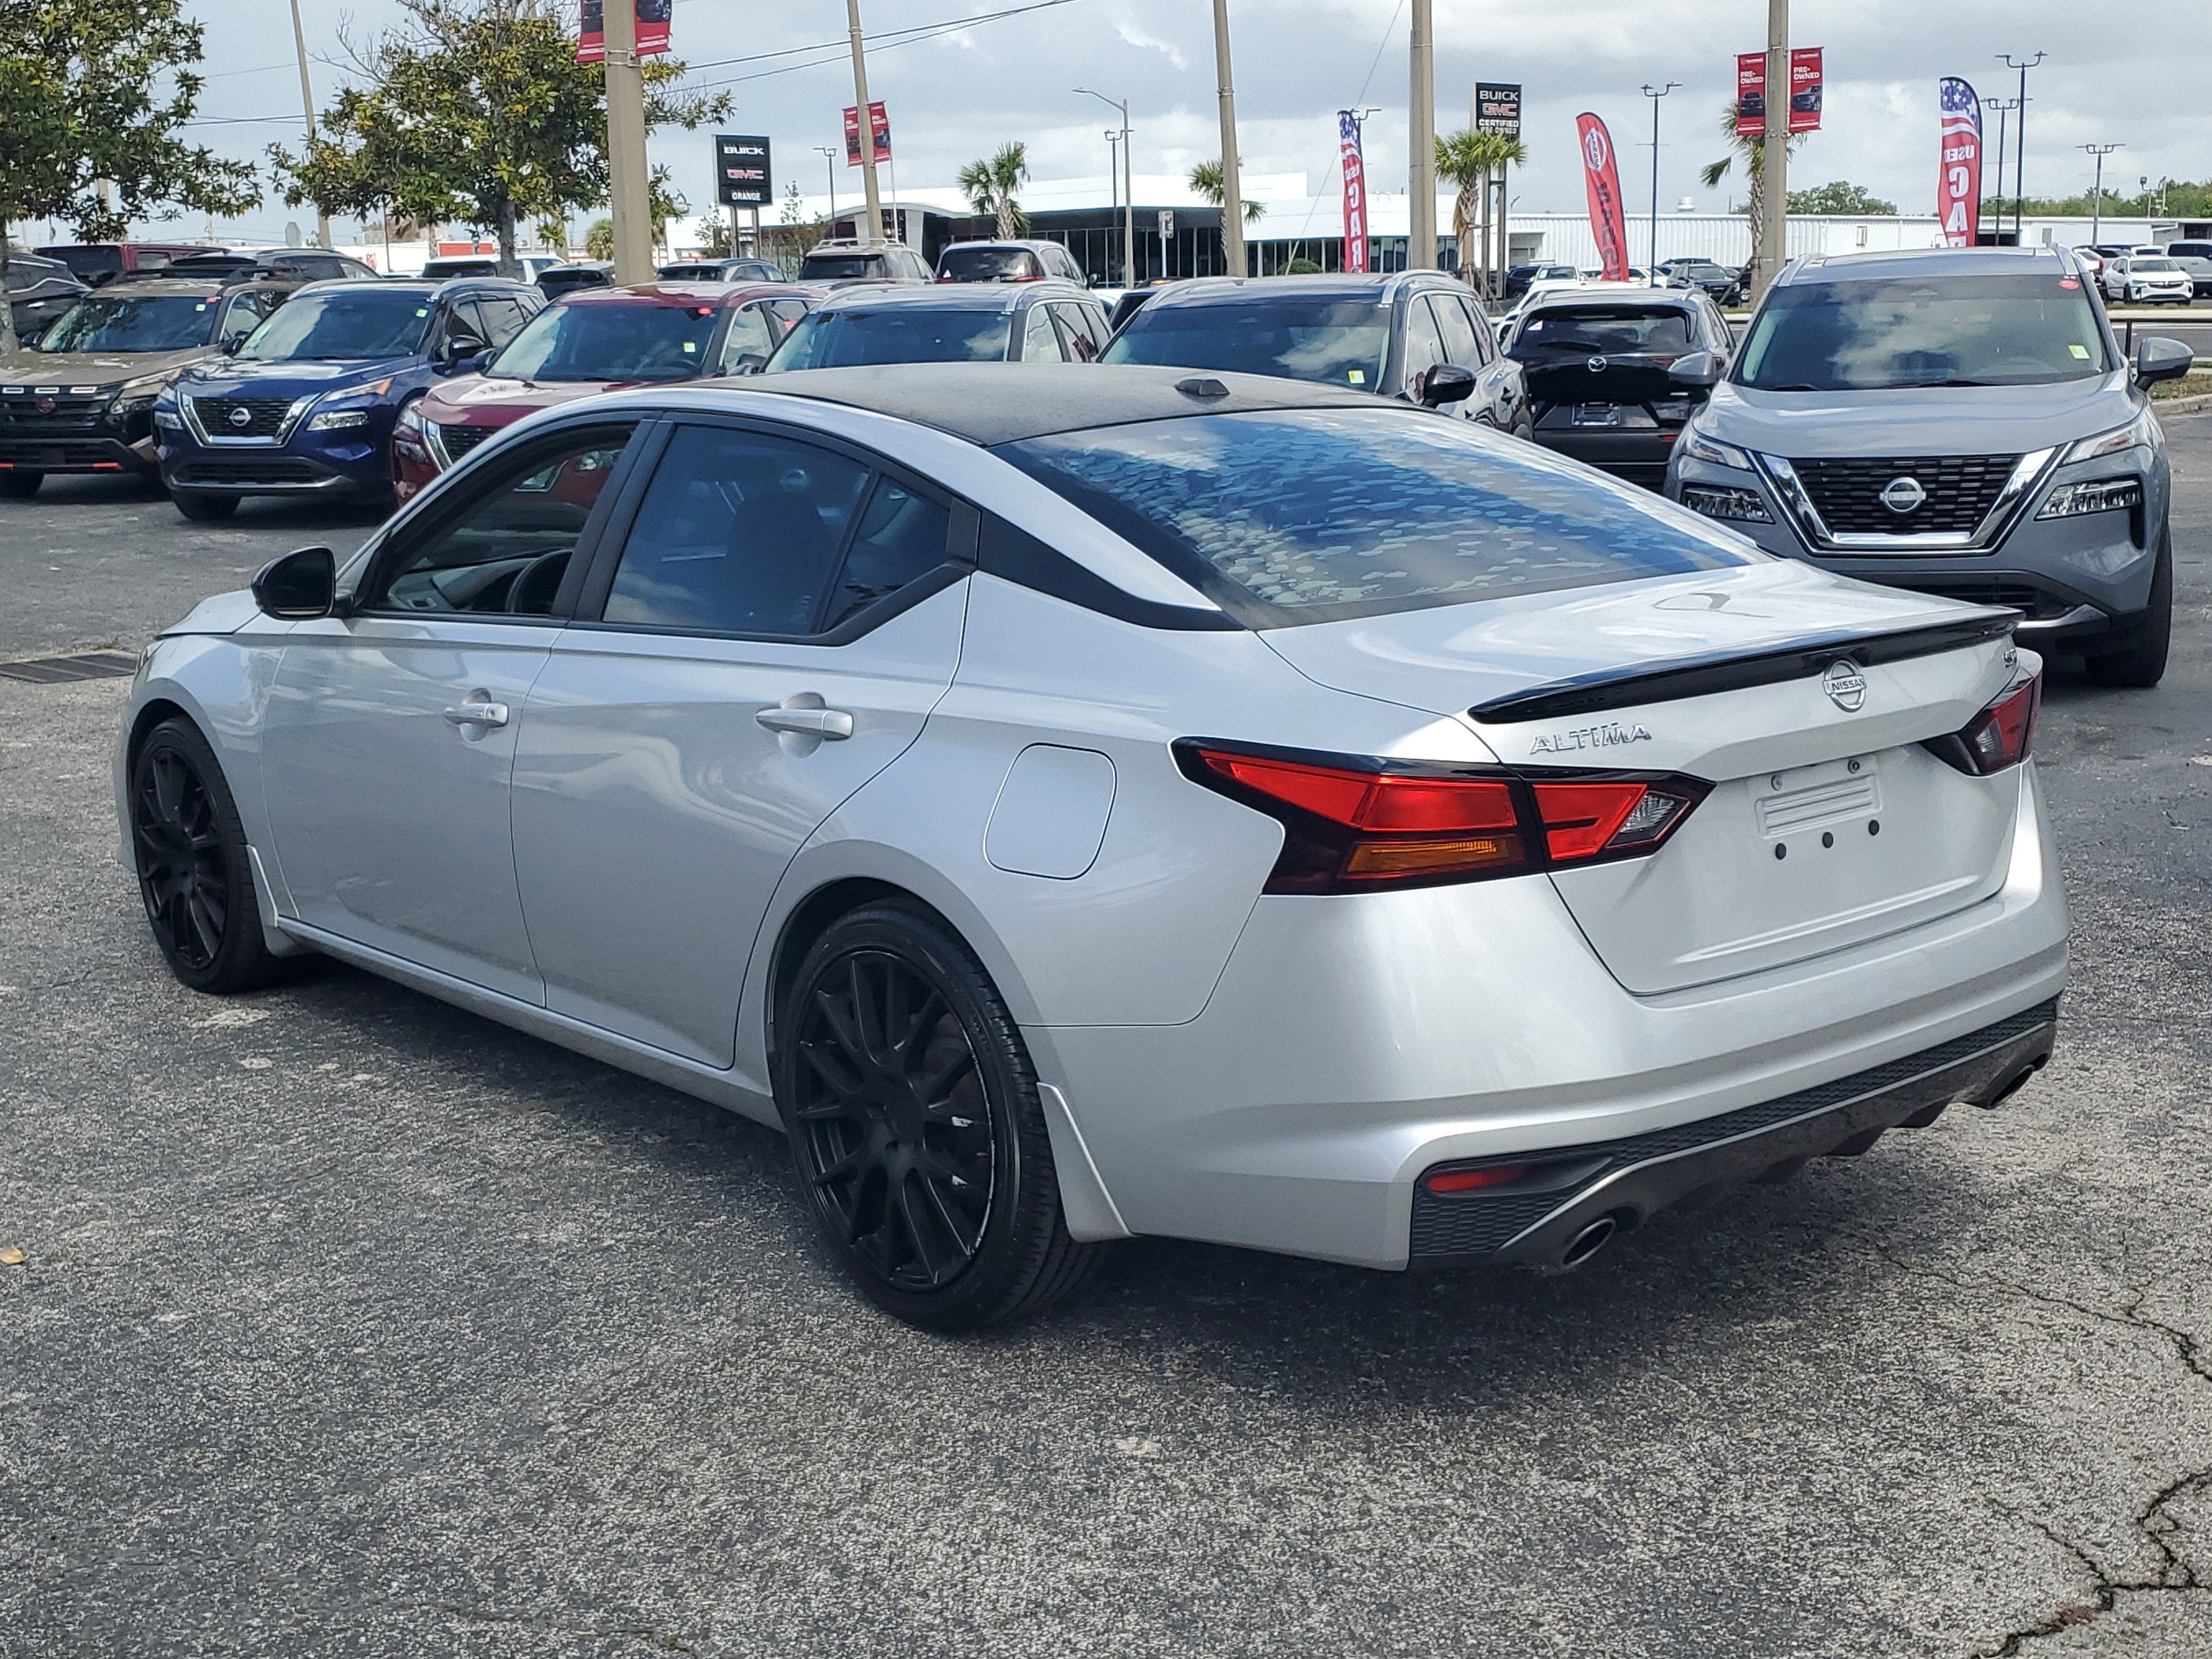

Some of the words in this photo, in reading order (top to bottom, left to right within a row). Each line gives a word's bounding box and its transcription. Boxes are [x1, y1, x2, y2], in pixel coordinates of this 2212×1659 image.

[1793, 72, 1820, 80] OWNED
[1480, 90, 1519, 101] BUICK
[1482, 103, 1517, 116] GMC
[1479, 119, 1519, 127] CERTIFIED
[724, 146, 765, 155] BUICK
[726, 168, 764, 179] GMC
[732, 191, 761, 201] ORANGE
[1831, 678, 1865, 692] NISSAN
[1530, 723, 1651, 755] ALTIMA
